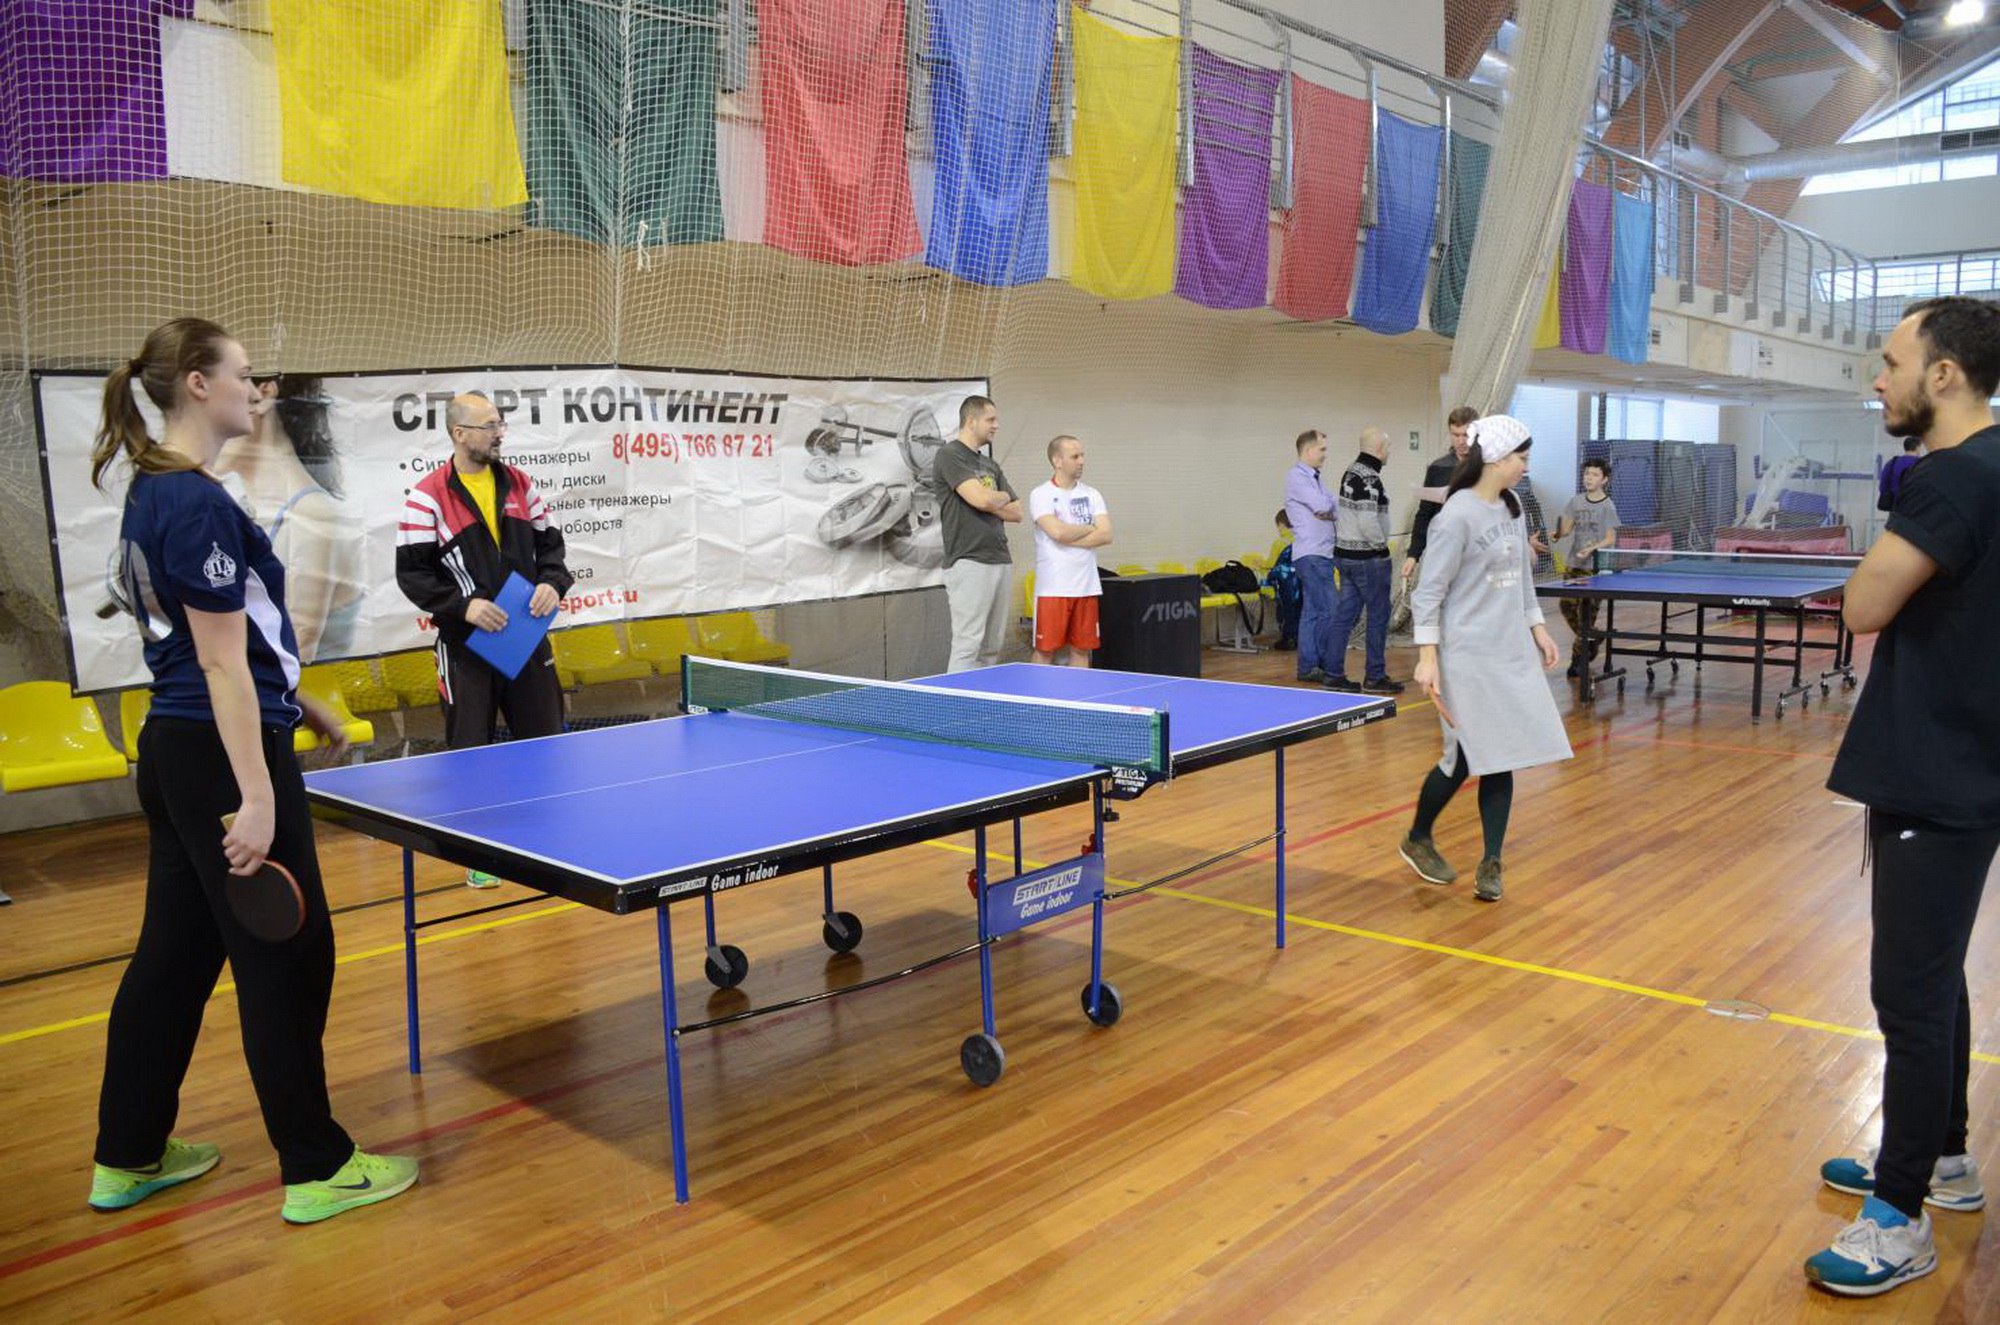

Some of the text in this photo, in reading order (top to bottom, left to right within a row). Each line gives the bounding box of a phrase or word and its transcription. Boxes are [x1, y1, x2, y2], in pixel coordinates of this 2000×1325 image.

[393, 386, 788, 431] СПРТ КОНТИНЕНТ
[501, 450, 590, 466] тренажеры
[613, 433, 679, 465] 8(495)
[682, 434, 717, 457] 766
[751, 434, 773, 457] 21
[562, 474, 606, 489] диски
[591, 494, 671, 510] тренажеры
[711, 863, 779, 892] Game indoor
[1021, 891, 1073, 919] Game indoor
